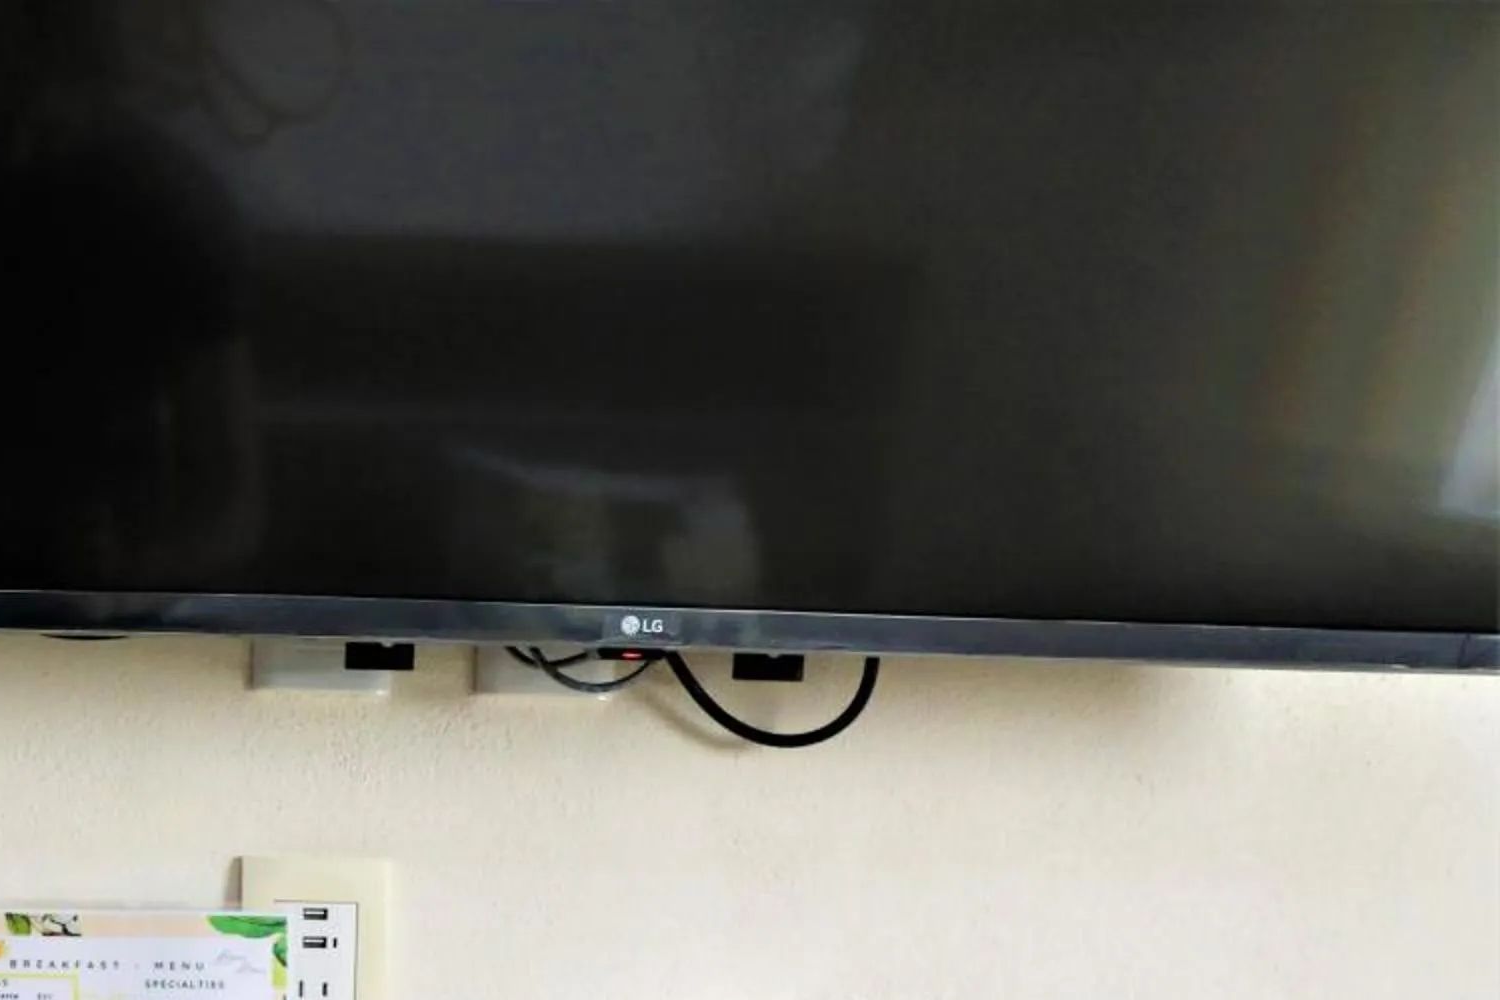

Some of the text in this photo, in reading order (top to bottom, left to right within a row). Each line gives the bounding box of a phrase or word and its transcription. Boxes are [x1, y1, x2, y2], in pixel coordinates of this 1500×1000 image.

[643, 619, 664, 633] LG
[9, 959, 120, 971] BREAKFAST
[153, 961, 206, 971] MENU
[144, 979, 226, 990] SPECIALTIES
